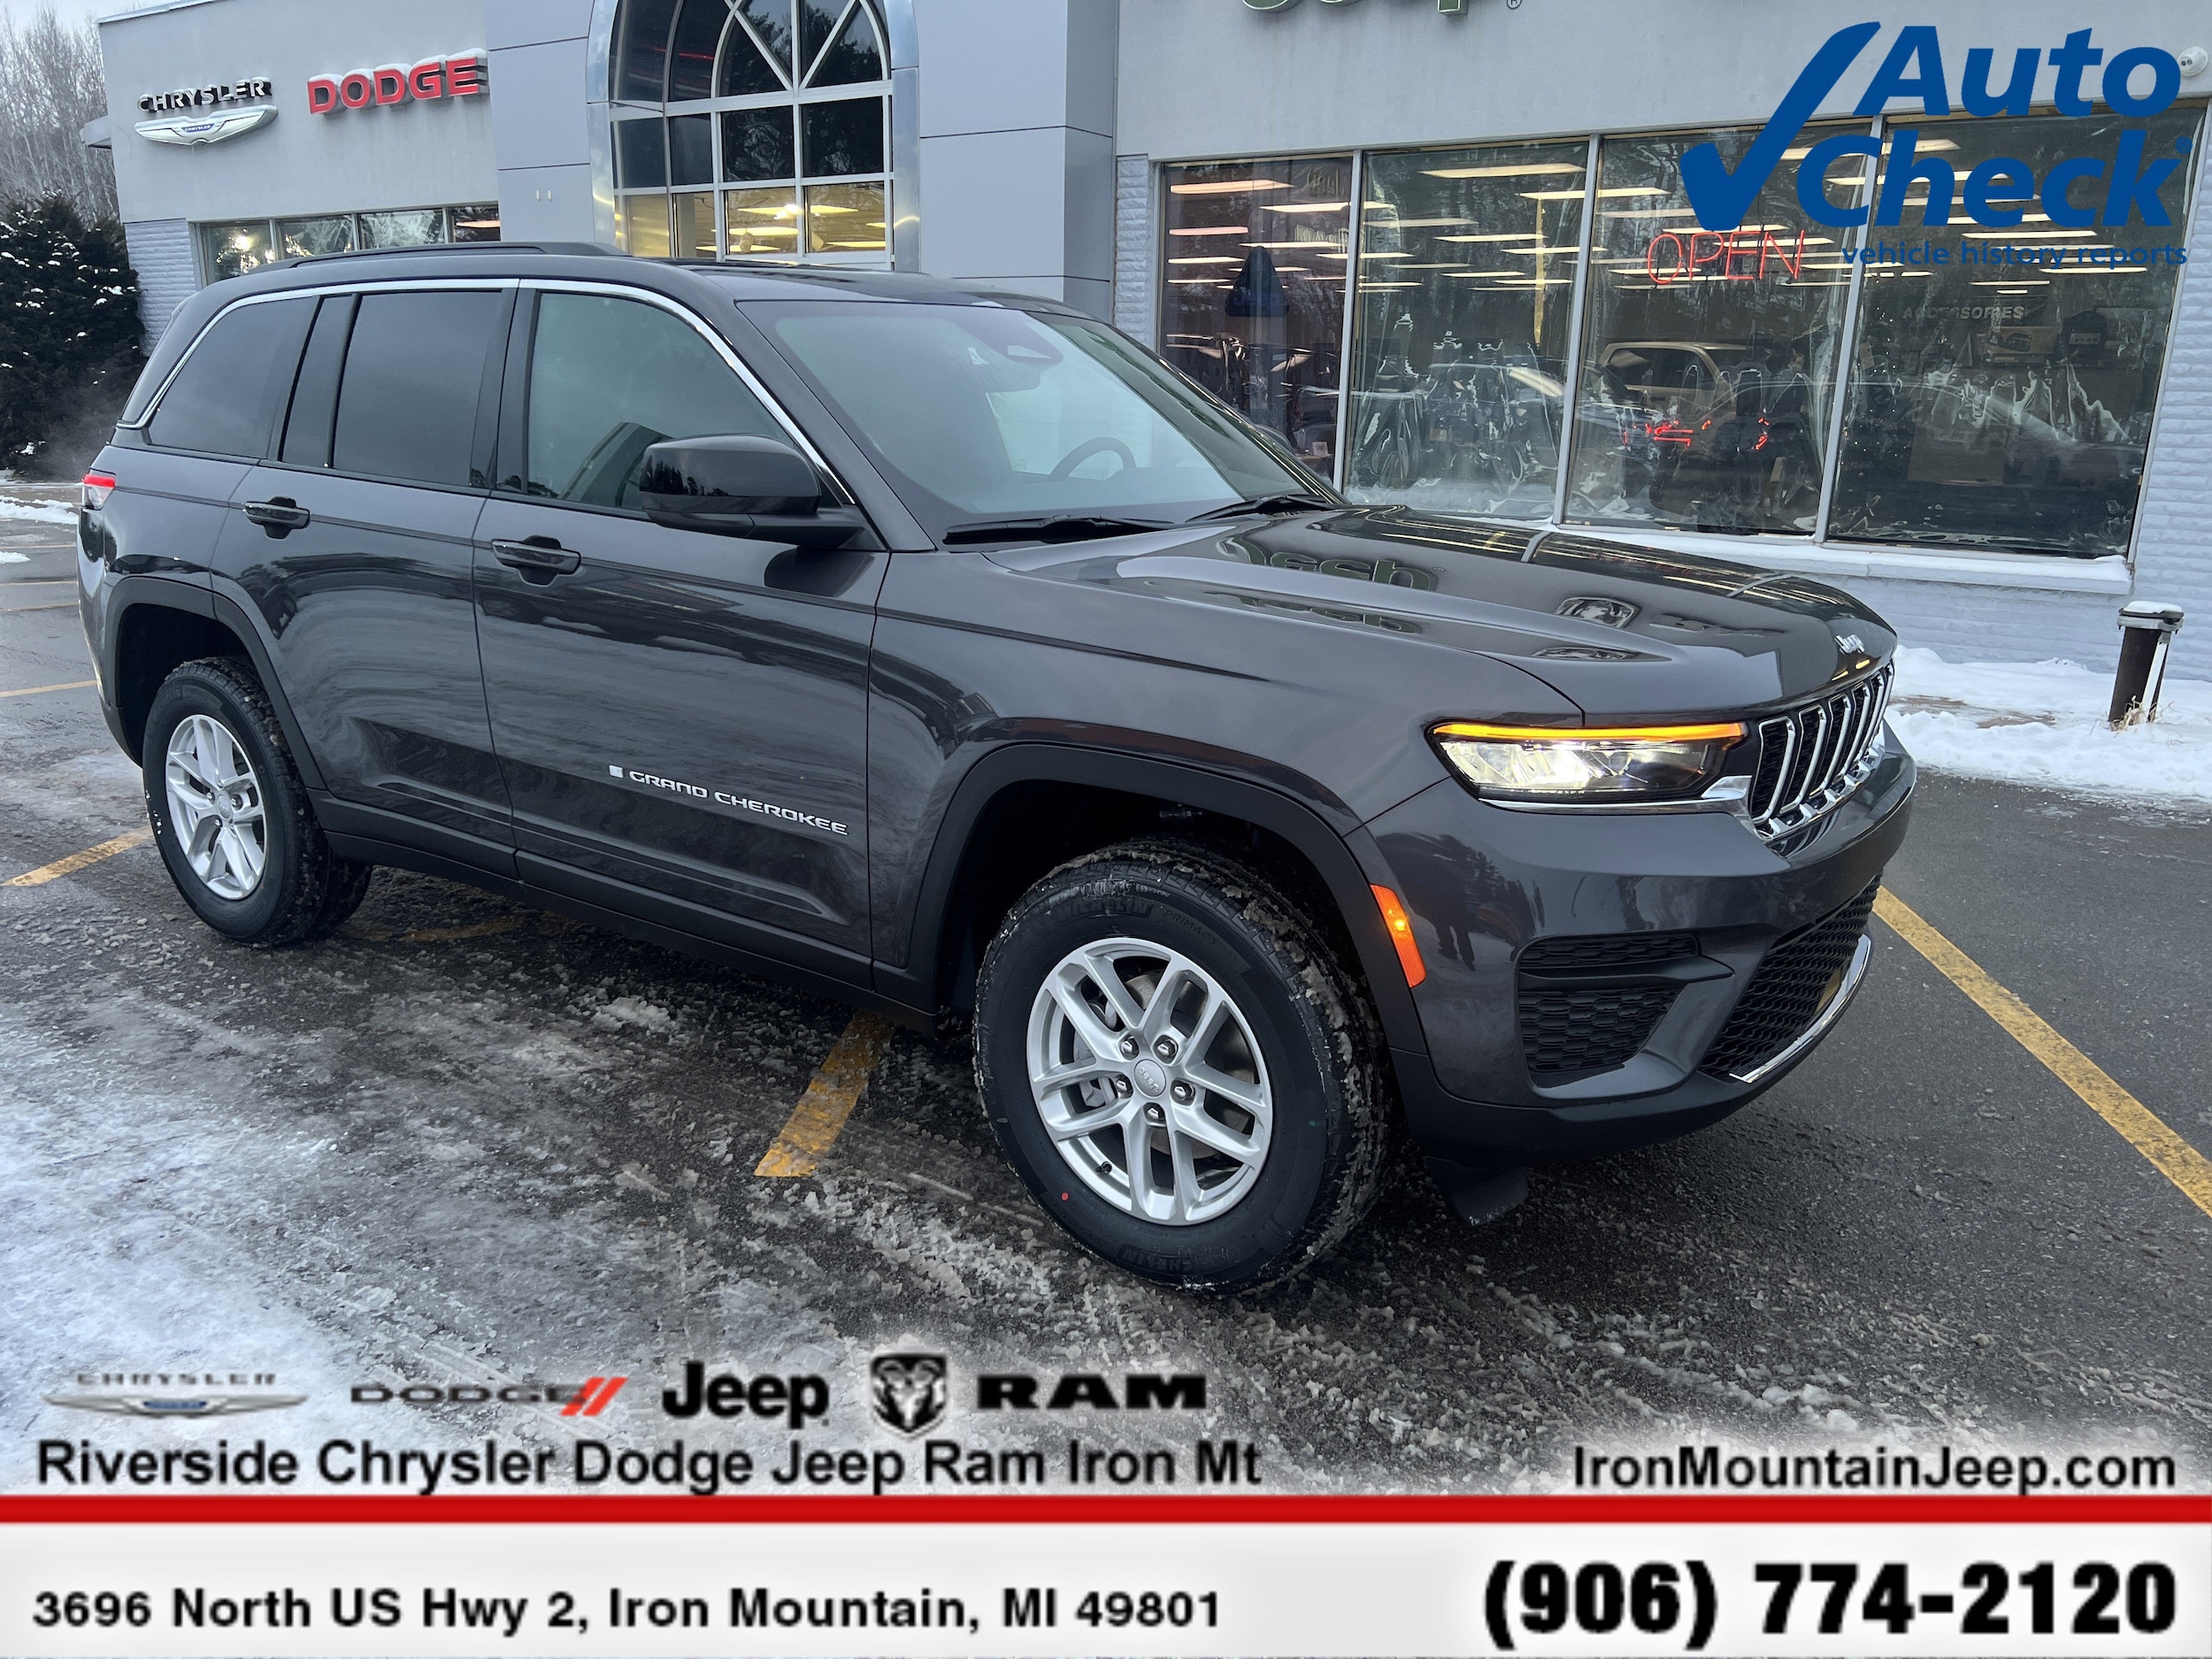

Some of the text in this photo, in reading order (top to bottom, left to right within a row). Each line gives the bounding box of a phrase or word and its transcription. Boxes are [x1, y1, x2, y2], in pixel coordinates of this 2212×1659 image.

[137, 76, 273, 113] CHRYSLER
[307, 53, 485, 115] DODGE
[1647, 230, 1805, 284] OPEN
[628, 771, 849, 835] GRAND CHEROKEE
[1164, 909, 1219, 946] PRIMACY
